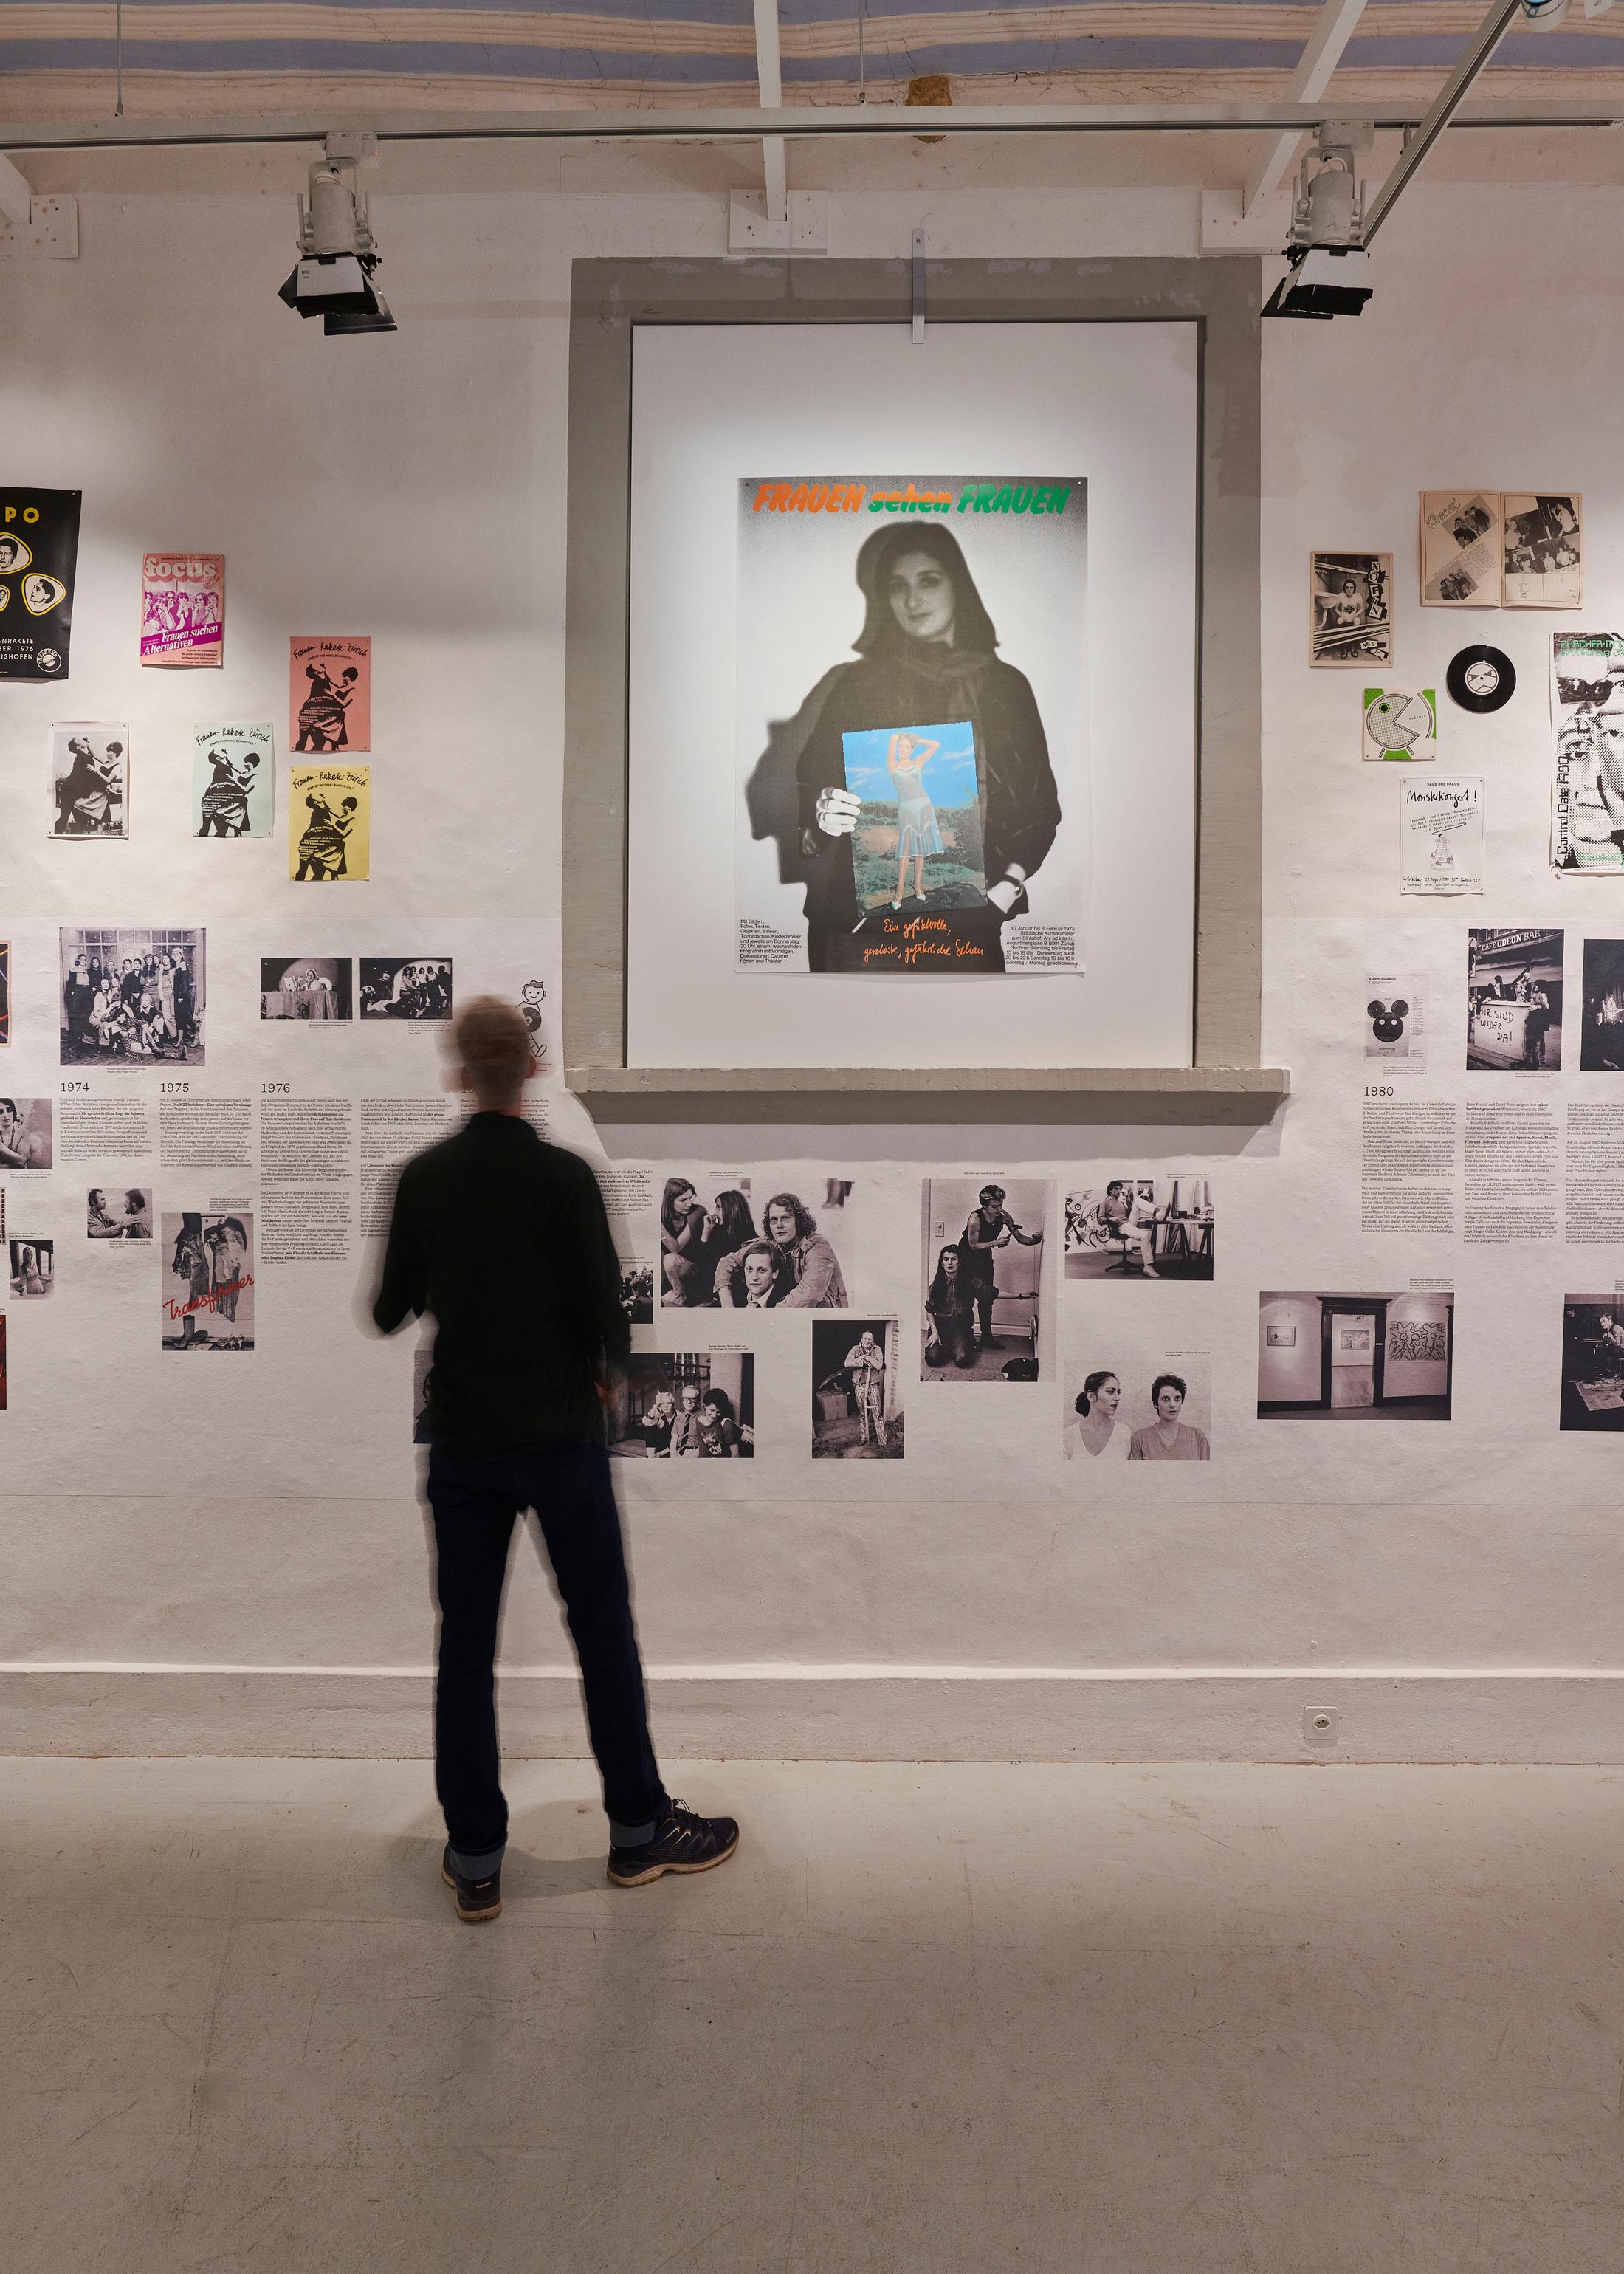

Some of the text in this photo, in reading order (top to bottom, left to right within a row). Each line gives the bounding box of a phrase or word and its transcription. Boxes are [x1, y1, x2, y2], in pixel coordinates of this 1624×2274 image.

[752, 484, 1071, 515] FRAUEN sehen FRAUEN
[145, 557, 217, 577] focus
[161, 631, 189, 642] Frauen
[190, 625, 218, 637] suchen
[143, 639, 193, 655] Alternativen
[1558, 756, 1569, 855] Control Date 1980
[884, 918, 899, 933] Eine
[1498, 935, 1522, 947] ODEON
[1524, 930, 1541, 941] BAR
[955, 938, 984, 958] Schau
[1480, 1008, 1514, 1024] WIR SIND
[1480, 1020, 1502, 1031] WIDER
[1497, 1031, 1513, 1046] DA!
[61, 1082, 89, 1092] 1974
[160, 1082, 189, 1093] 1975
[261, 1083, 290, 1093] 1976
[1364, 1086, 1394, 1096] 1980
[163, 1274, 254, 1320] Transformer
